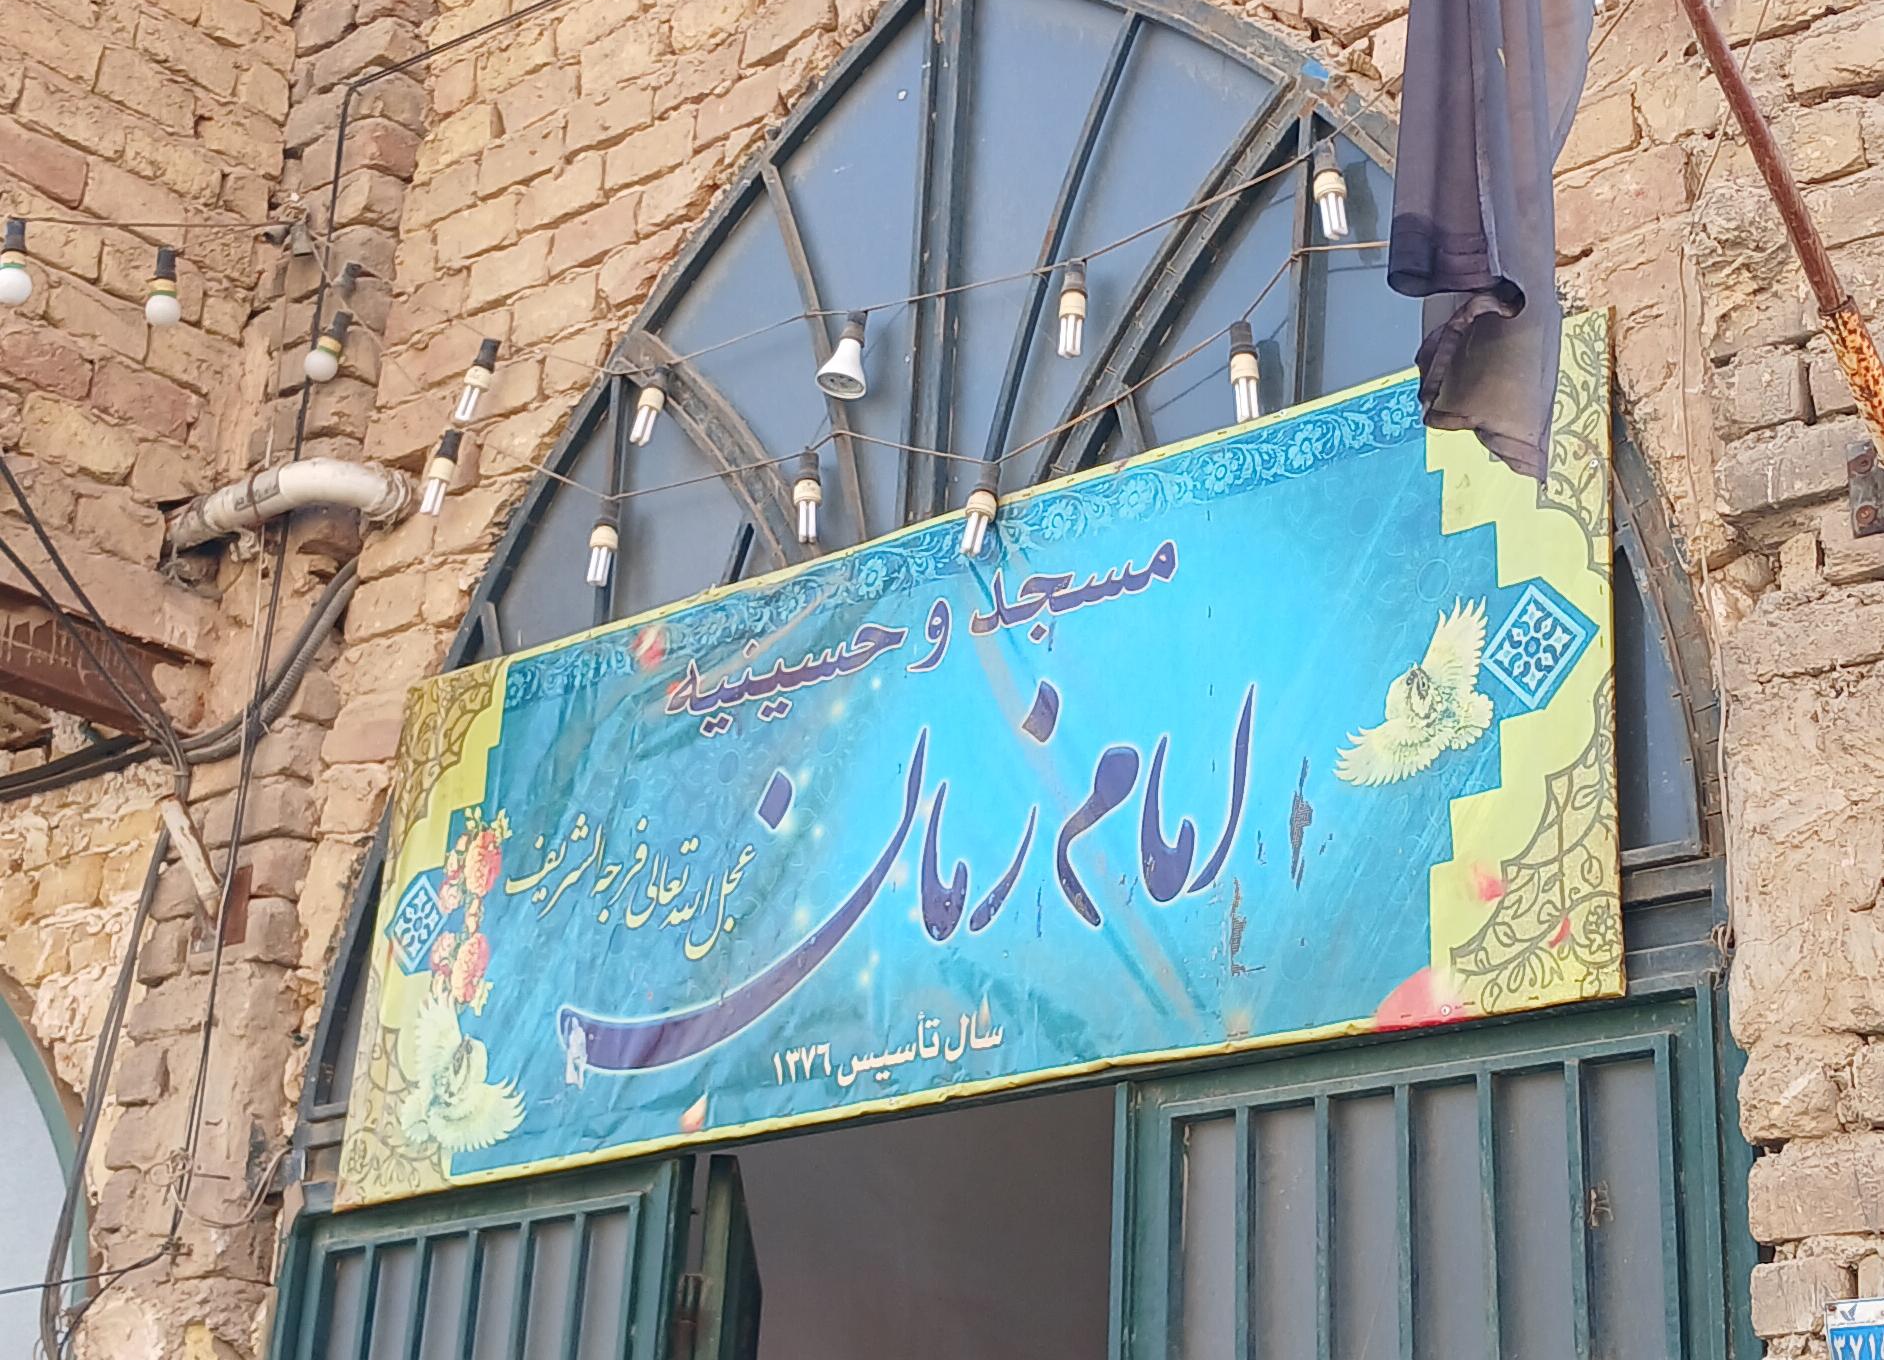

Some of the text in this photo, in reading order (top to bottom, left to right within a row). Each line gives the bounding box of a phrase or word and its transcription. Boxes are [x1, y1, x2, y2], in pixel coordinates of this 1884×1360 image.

[665, 539, 1178, 737] مسجد و حسینیه
[504, 813, 605, 921] الشریف
[558, 680, 1256, 1072] امام زمان
[590, 816, 648, 924] فرجه
[625, 837, 699, 929] تعالی
[684, 844, 757, 960] عجل
[837, 1010, 941, 1087] تأسیس
[944, 1011, 1004, 1062] سال
